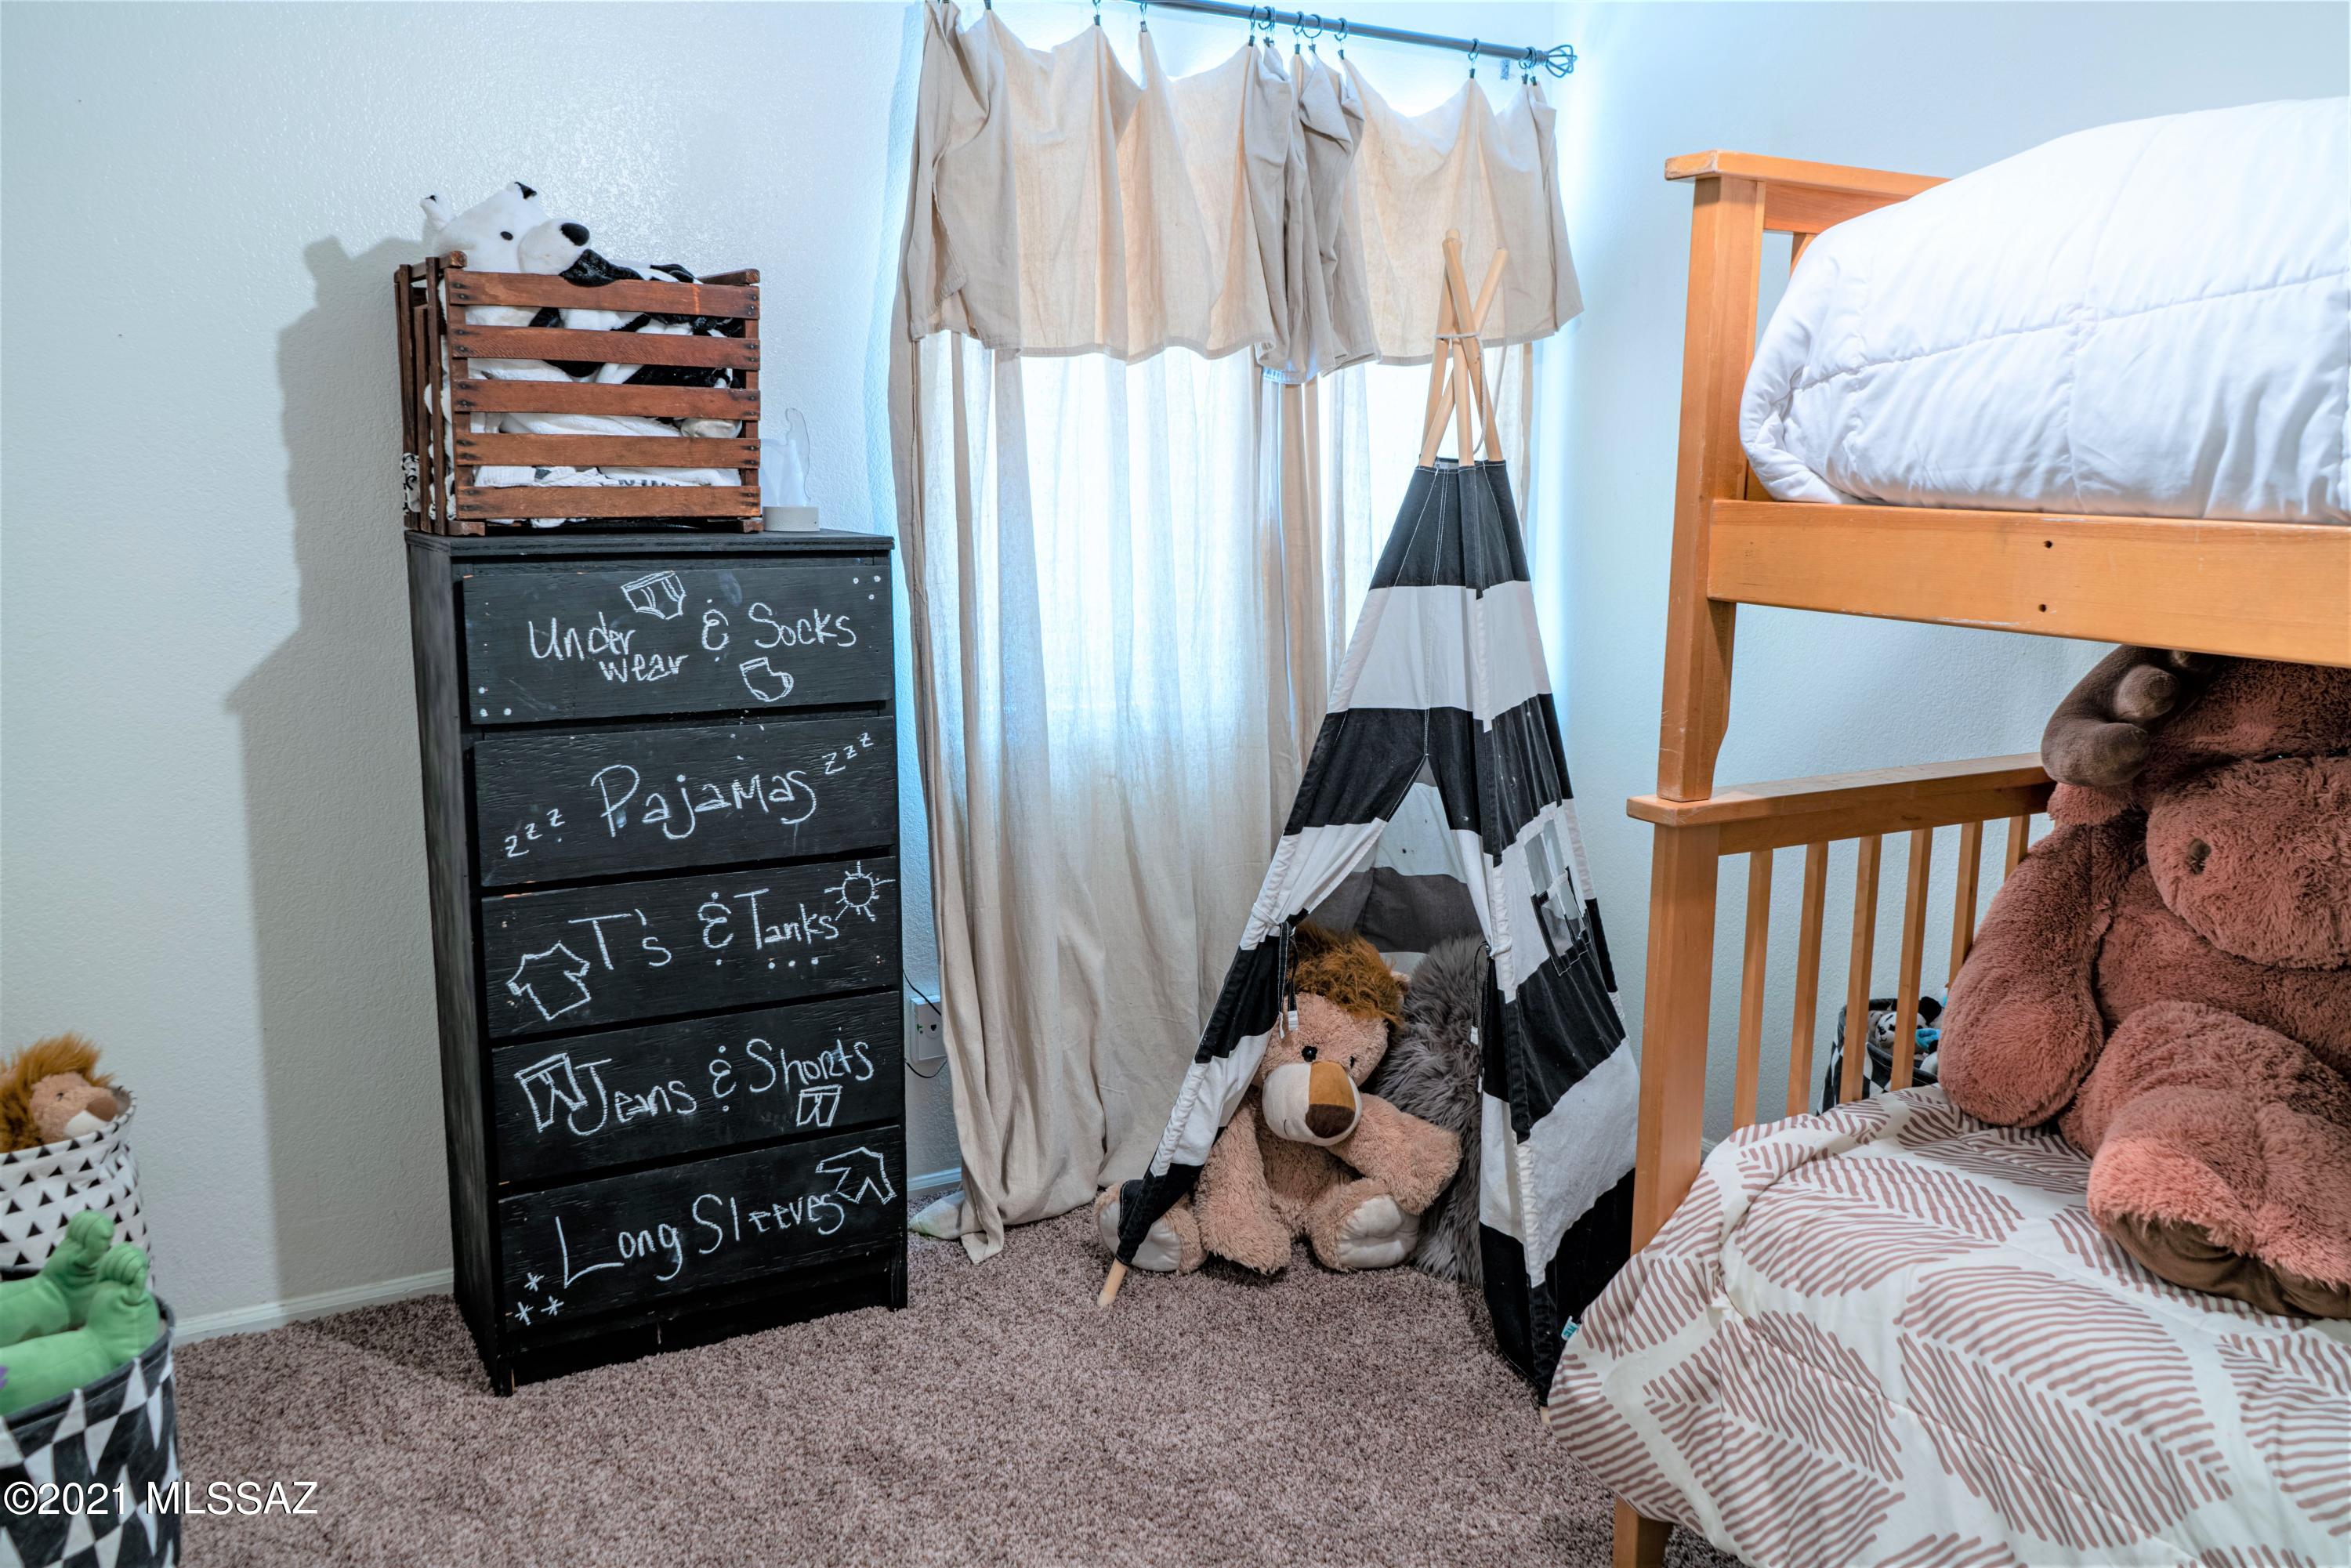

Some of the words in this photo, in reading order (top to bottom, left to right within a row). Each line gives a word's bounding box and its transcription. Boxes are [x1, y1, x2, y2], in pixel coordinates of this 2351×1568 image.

[529, 611, 636, 661] Under
[749, 603, 857, 649] Socks
[734, 889, 839, 950] Tanks
[567, 1059, 697, 1136] Jeans
[555, 1216, 683, 1289] Long
